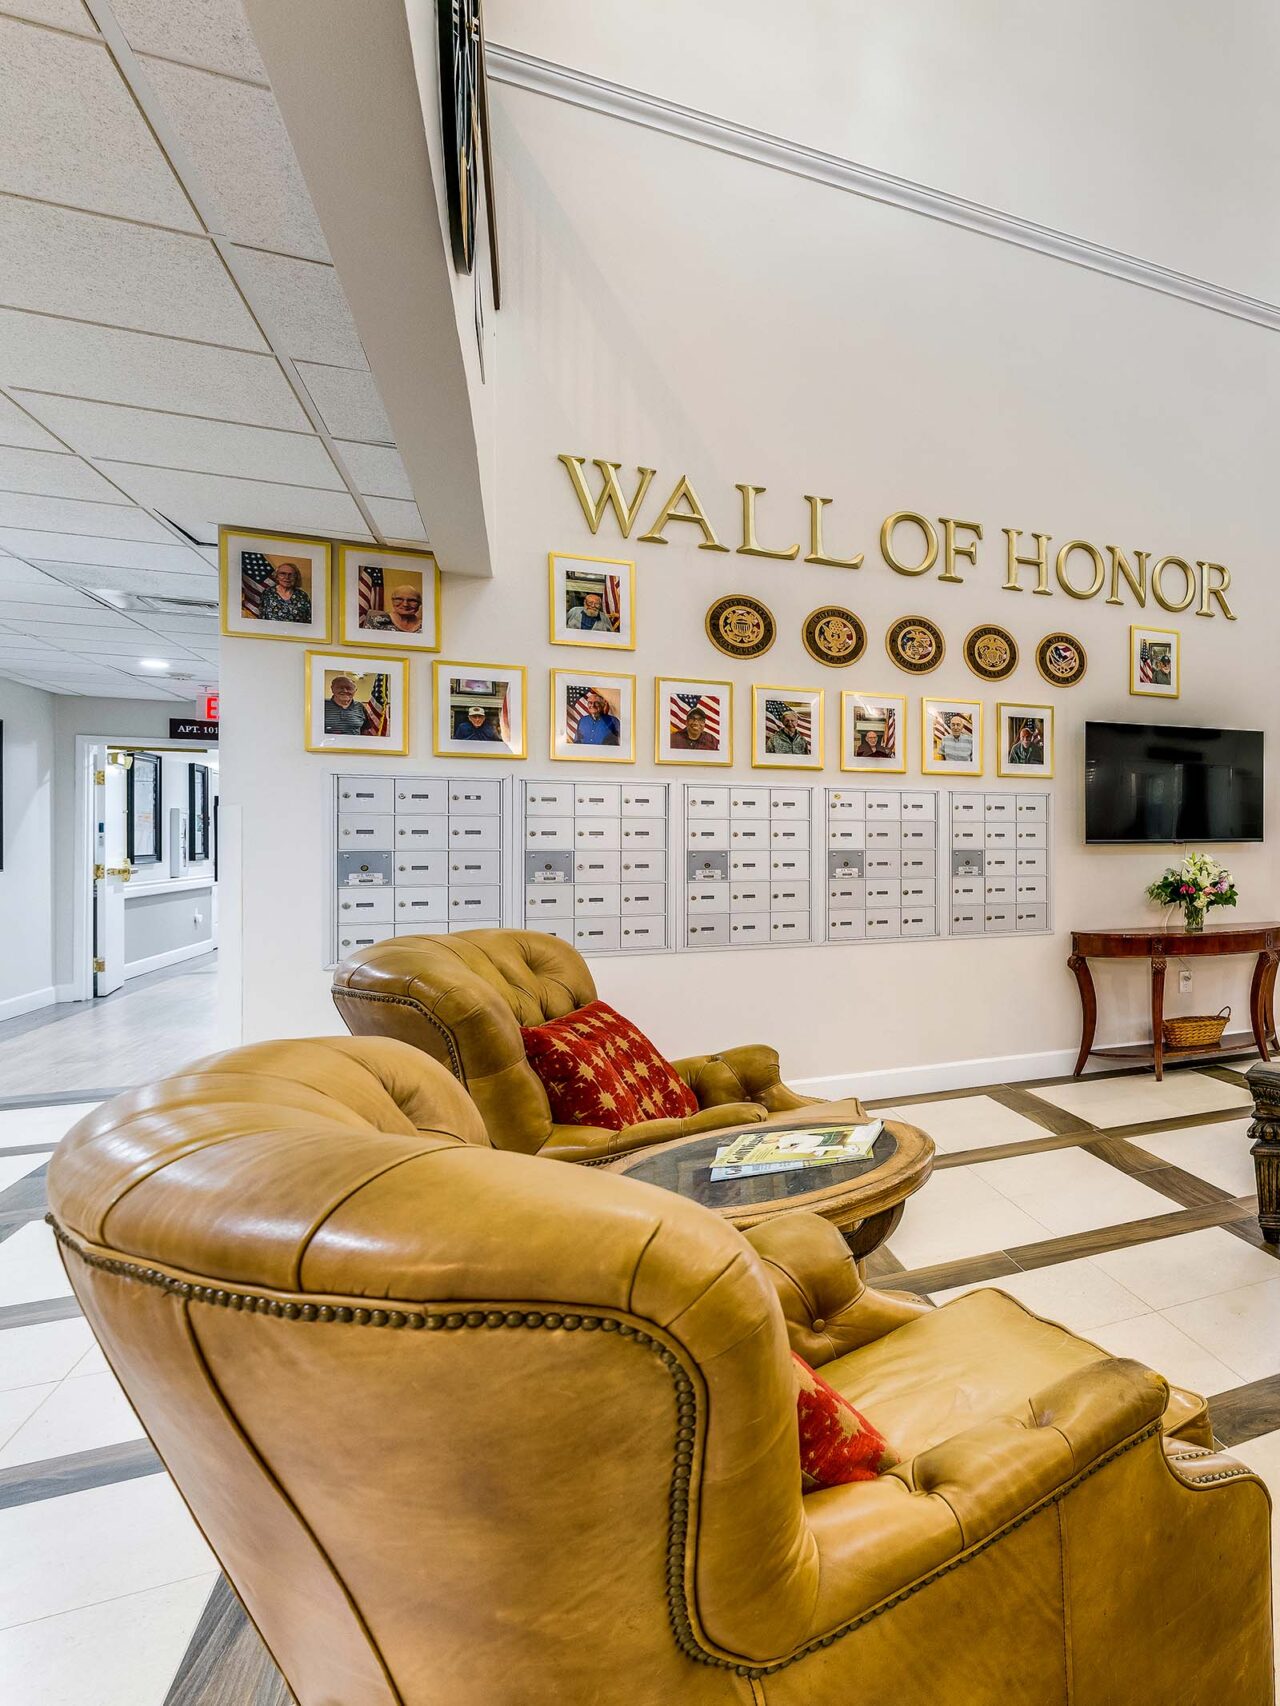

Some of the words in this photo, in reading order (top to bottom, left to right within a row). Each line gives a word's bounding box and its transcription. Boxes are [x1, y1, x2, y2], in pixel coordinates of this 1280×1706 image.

[557, 453, 865, 570] WALL
[880, 509, 984, 583] OF
[1001, 526, 1239, 621] HONOR
[177, 725, 201, 733] APT.
